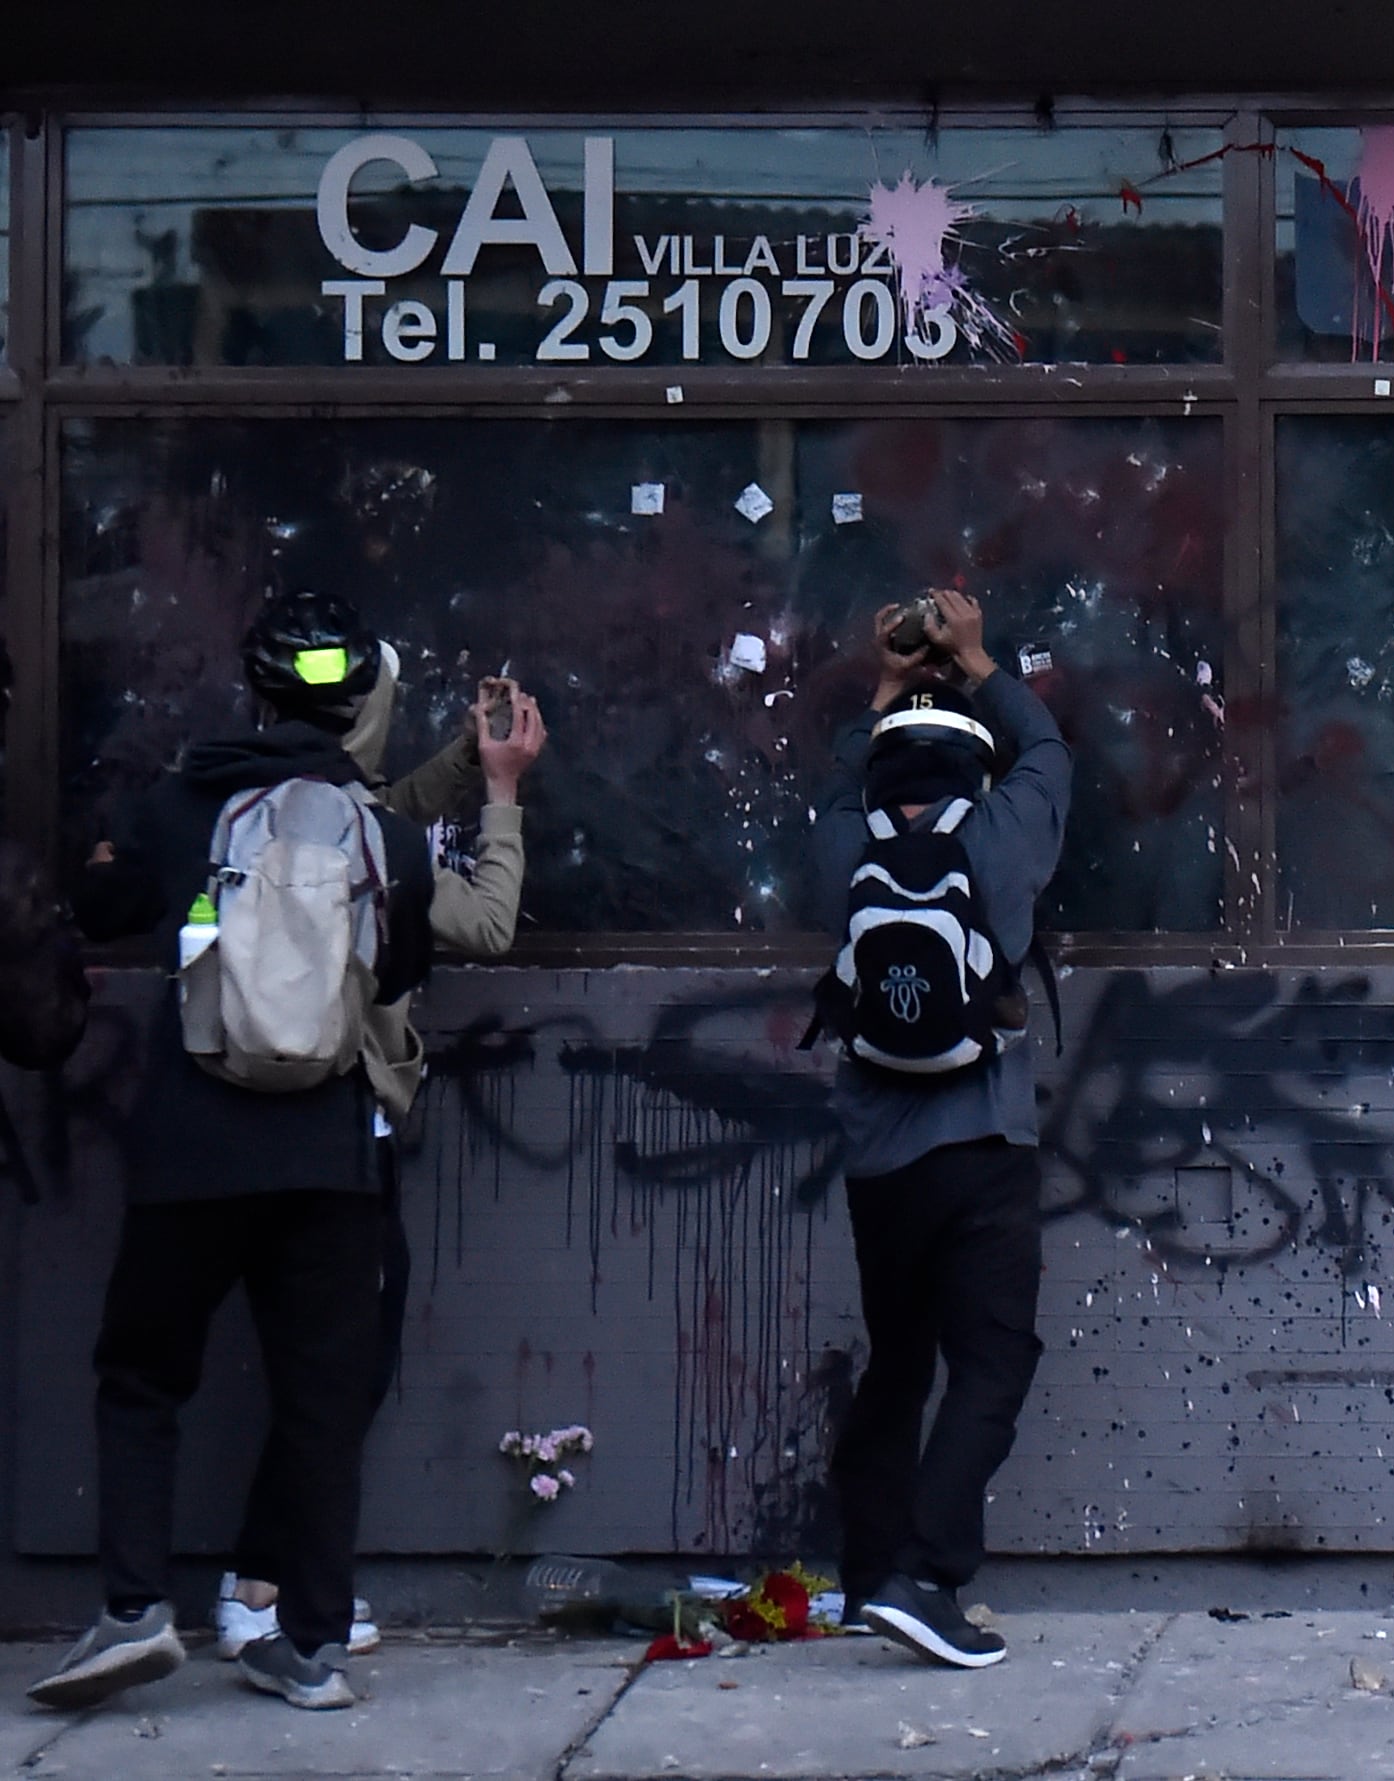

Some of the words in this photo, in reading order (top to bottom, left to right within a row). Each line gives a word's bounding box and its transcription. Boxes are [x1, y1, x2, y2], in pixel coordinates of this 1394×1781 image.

[316, 134, 615, 277] CAI
[633, 235, 780, 276] VILLA
[321, 280, 496, 361] Tel.
[910, 693, 934, 711] 15
